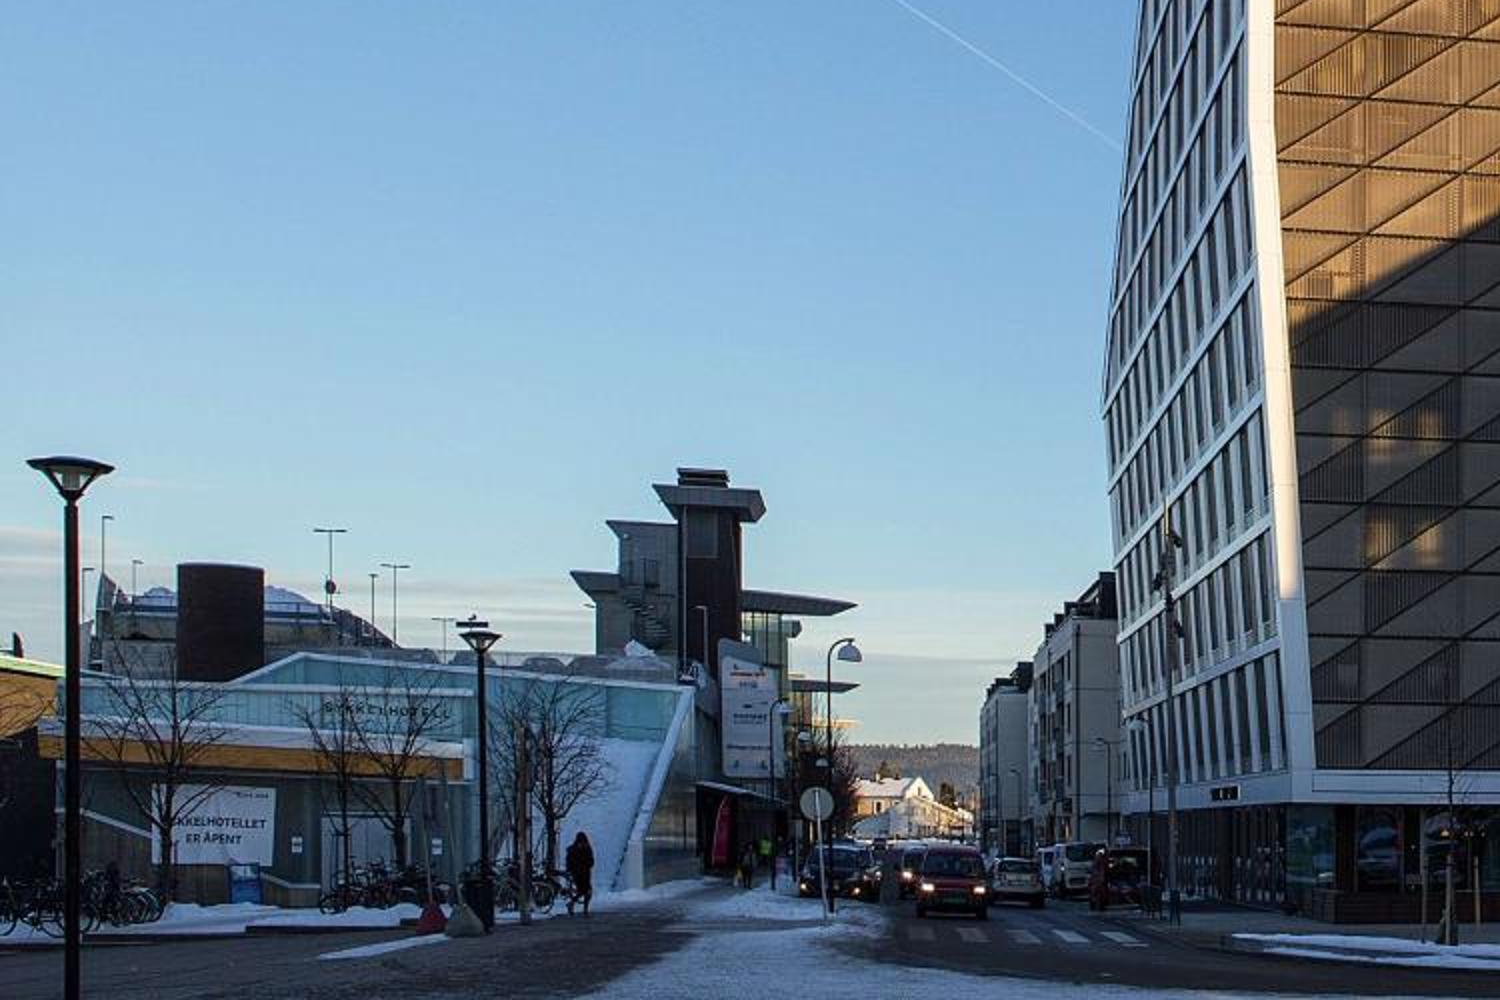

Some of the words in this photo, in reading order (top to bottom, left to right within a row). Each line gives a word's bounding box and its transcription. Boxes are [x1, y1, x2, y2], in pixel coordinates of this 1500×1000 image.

[173, 817, 267, 829] KKELHOTELLET
[186, 834, 201, 844] ER
[203, 831, 242, 845] ÅPENT
